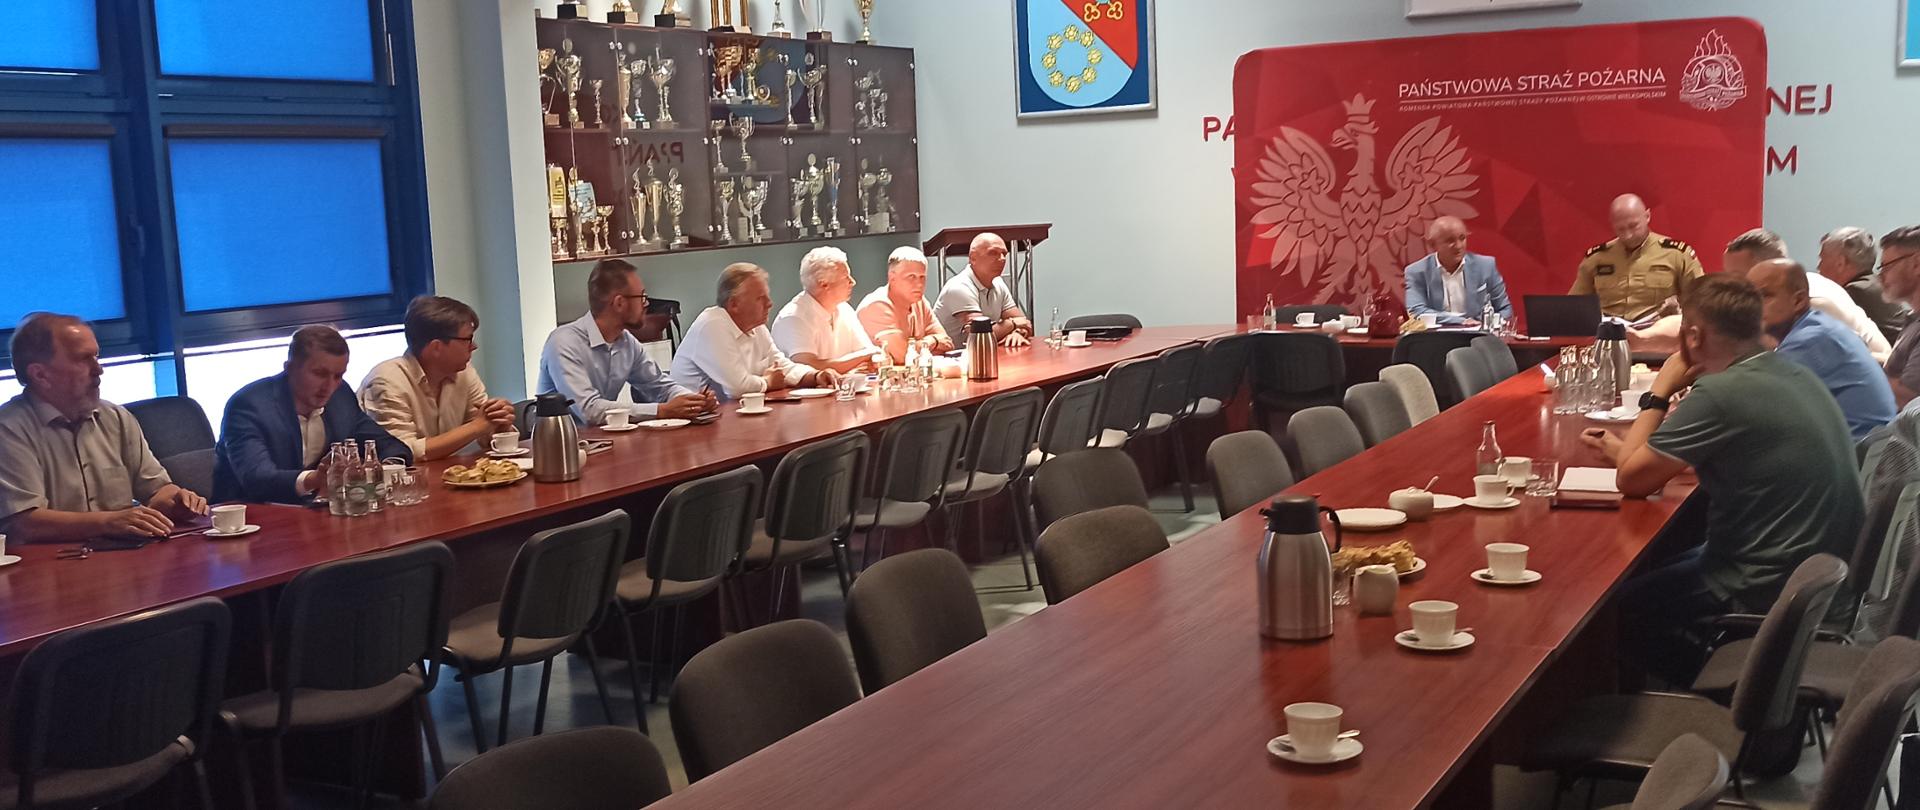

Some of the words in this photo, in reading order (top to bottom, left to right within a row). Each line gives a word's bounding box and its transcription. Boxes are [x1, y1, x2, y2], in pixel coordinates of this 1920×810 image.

[1399, 76, 1513, 98] PAŃSTWOWA
[1517, 69, 1574, 91] STRAŻ
[1578, 67, 1666, 88] POŻARNA
